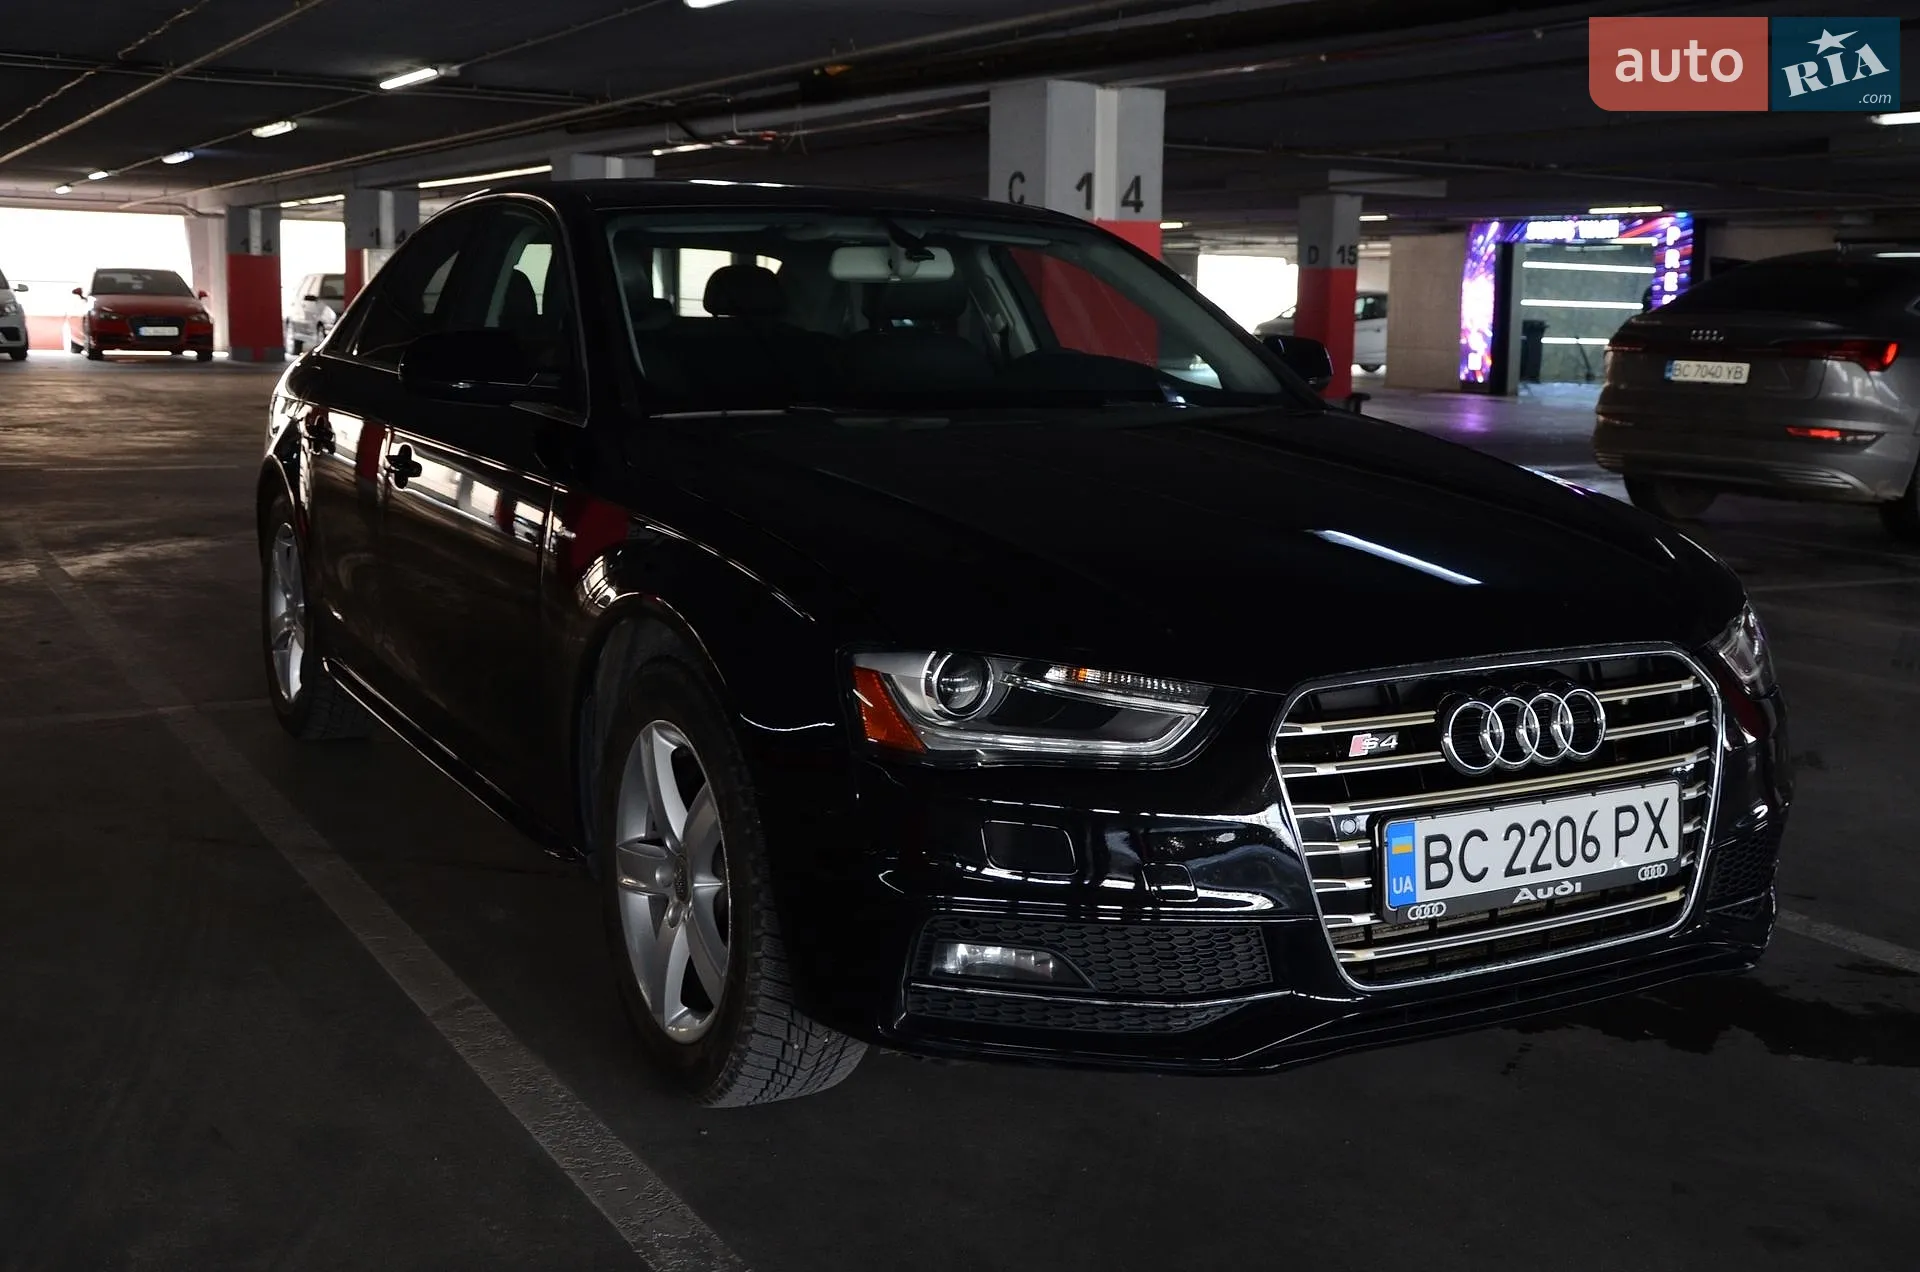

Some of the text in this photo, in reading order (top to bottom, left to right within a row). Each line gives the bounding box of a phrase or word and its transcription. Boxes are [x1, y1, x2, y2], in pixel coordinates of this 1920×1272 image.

[1008, 171, 1025, 204] C
[1307, 245, 1357, 265] D 15
[1672, 363, 1690, 377] BC
[1695, 364, 1723, 379] 7040
[1360, 733, 1399, 751] S4
[1423, 797, 1669, 891] BC 2206 PX
[1392, 876, 1414, 895] UA
[1512, 881, 1582, 904] Audi
